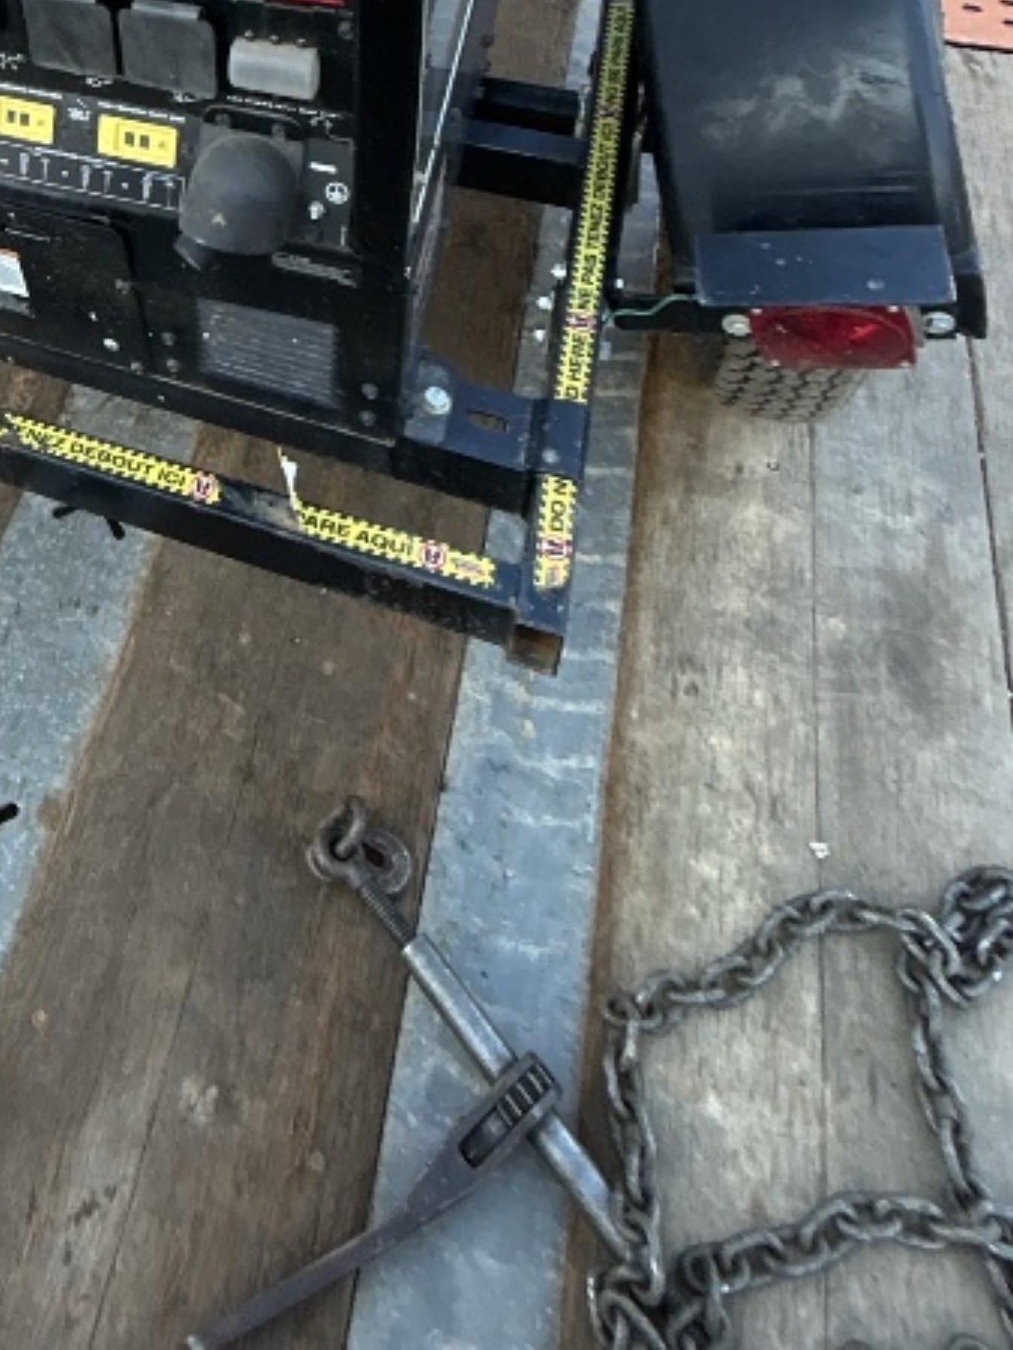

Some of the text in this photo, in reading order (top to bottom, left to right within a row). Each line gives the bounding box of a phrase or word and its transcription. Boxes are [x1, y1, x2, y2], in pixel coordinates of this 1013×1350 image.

[70, 443, 152, 475] DEBOUT
[300, 511, 414, 556] ARE AQUI
